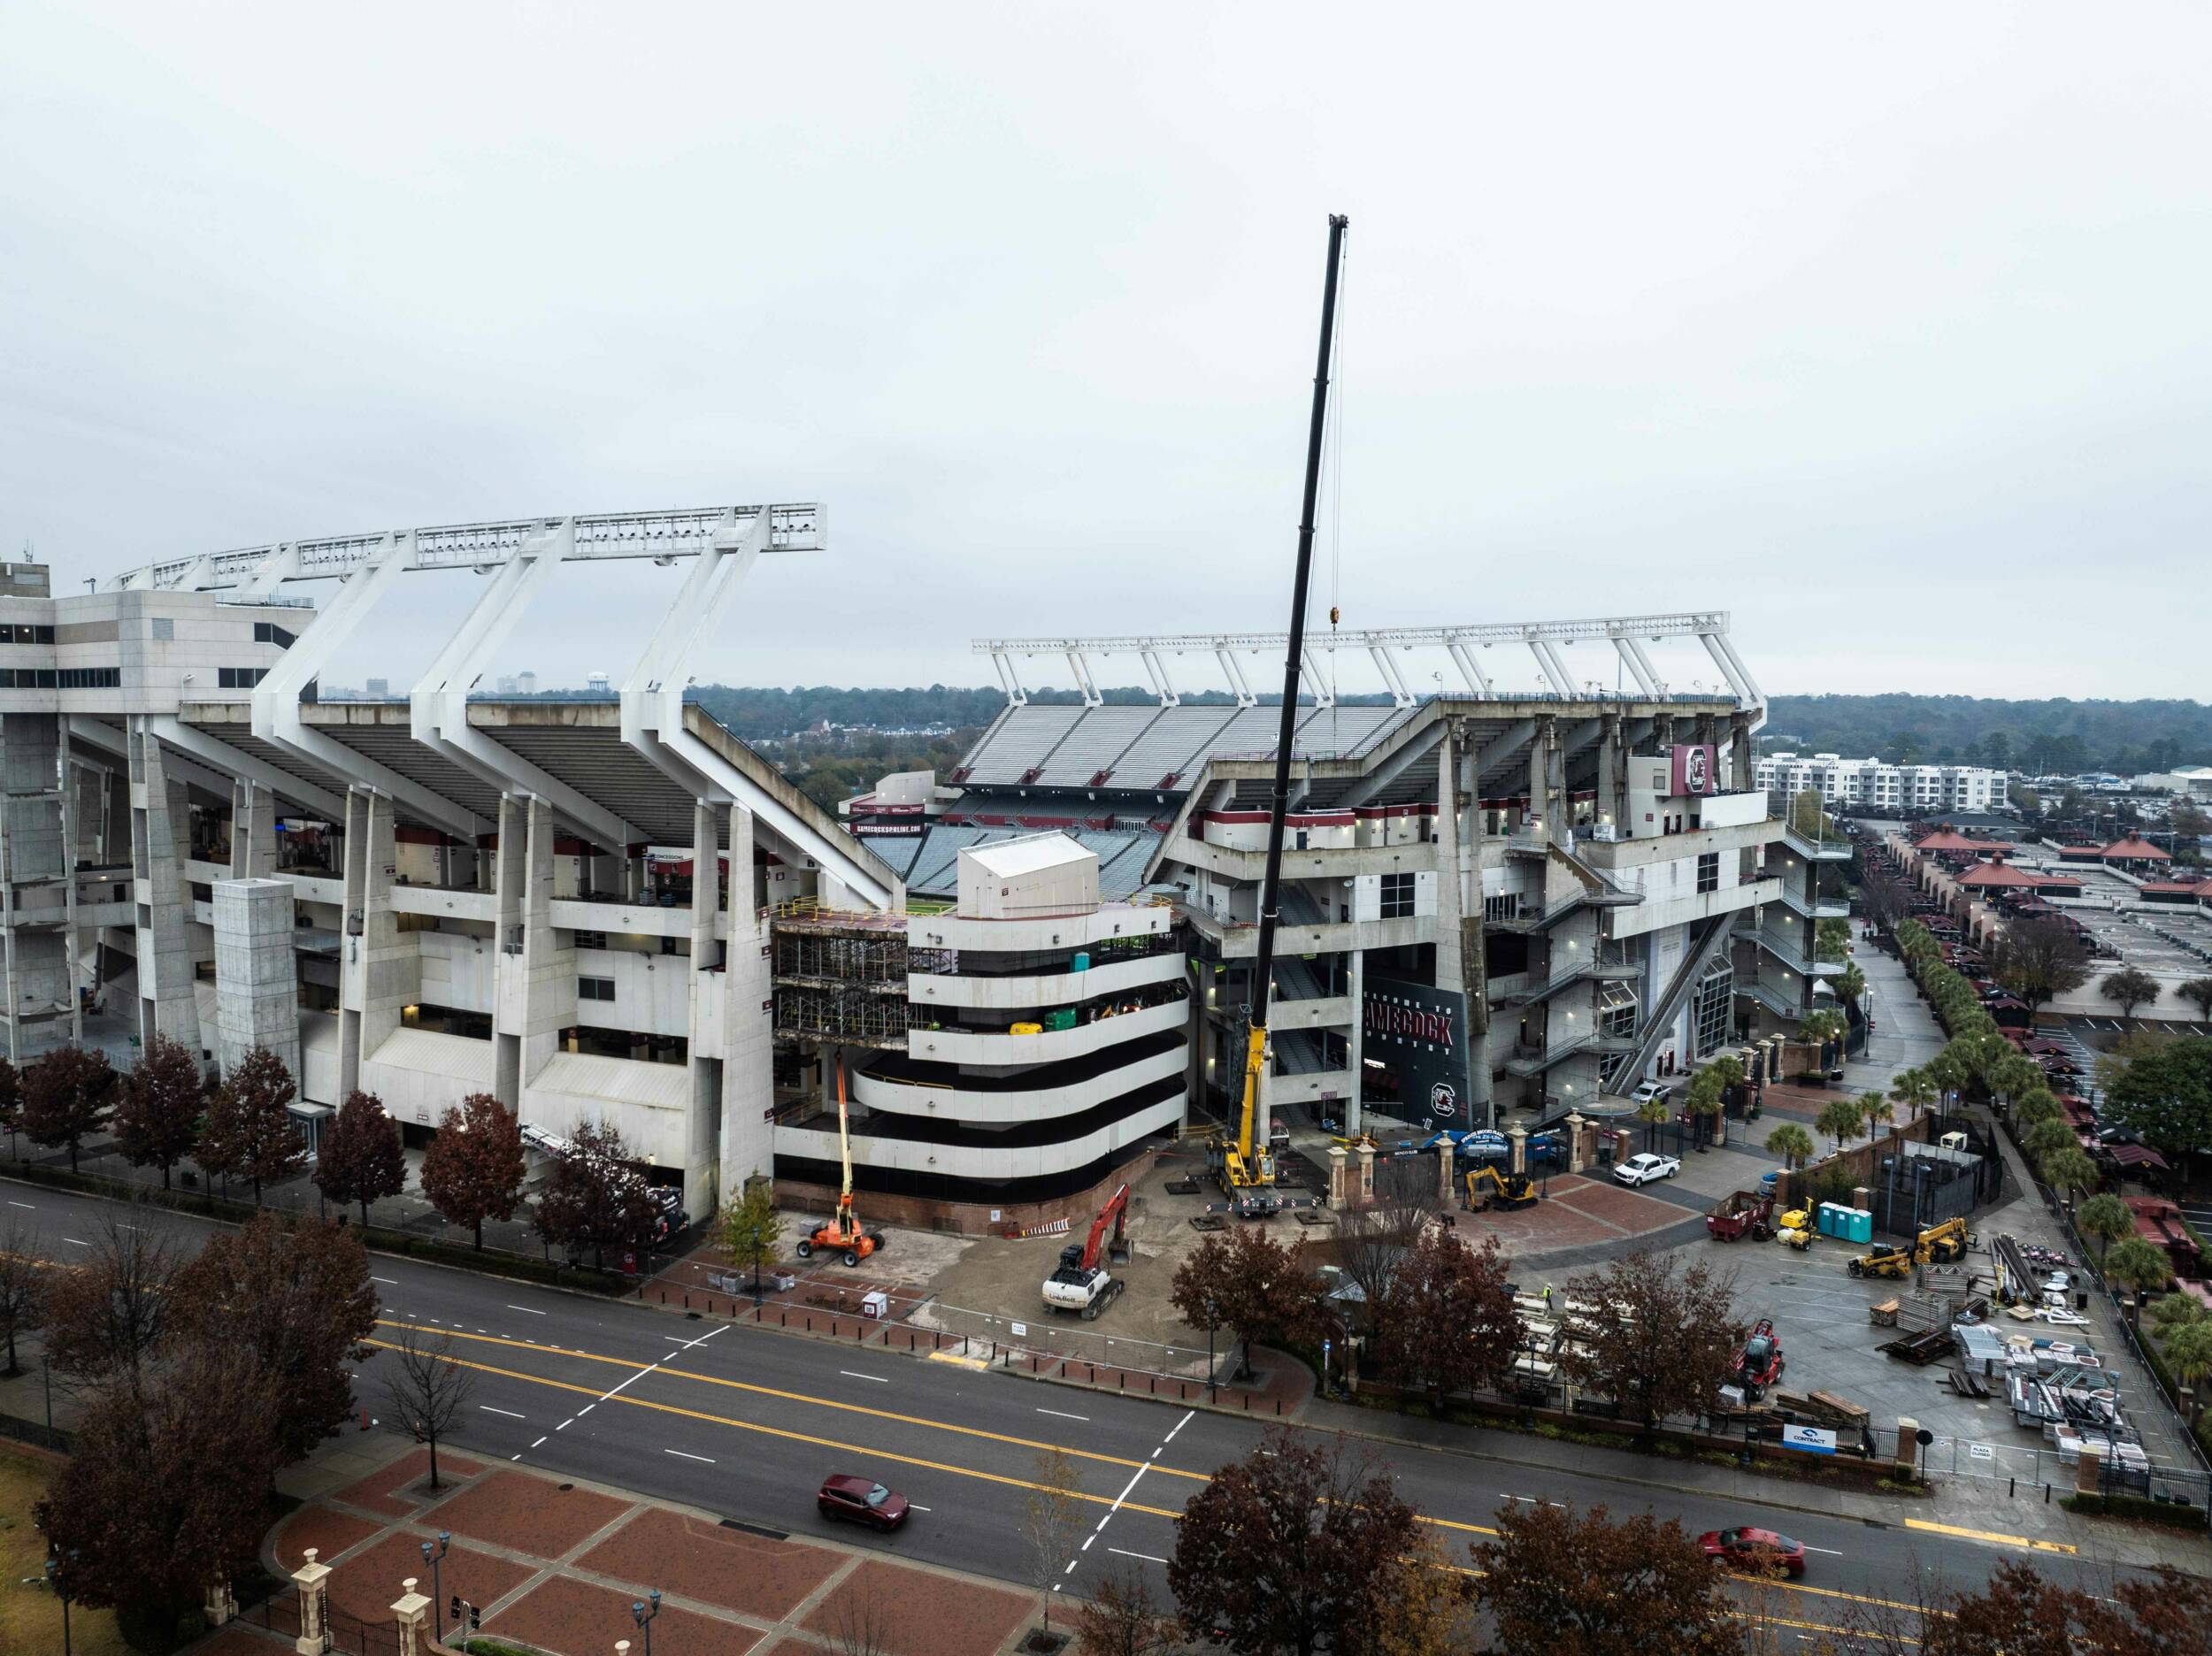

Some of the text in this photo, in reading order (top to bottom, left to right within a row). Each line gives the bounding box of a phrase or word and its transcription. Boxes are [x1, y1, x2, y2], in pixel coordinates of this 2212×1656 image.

[1435, 1005, 1451, 1015] TO
[1362, 1001, 1453, 1046] AMECOCK
[1793, 1435, 1825, 1445] CONTRACT
